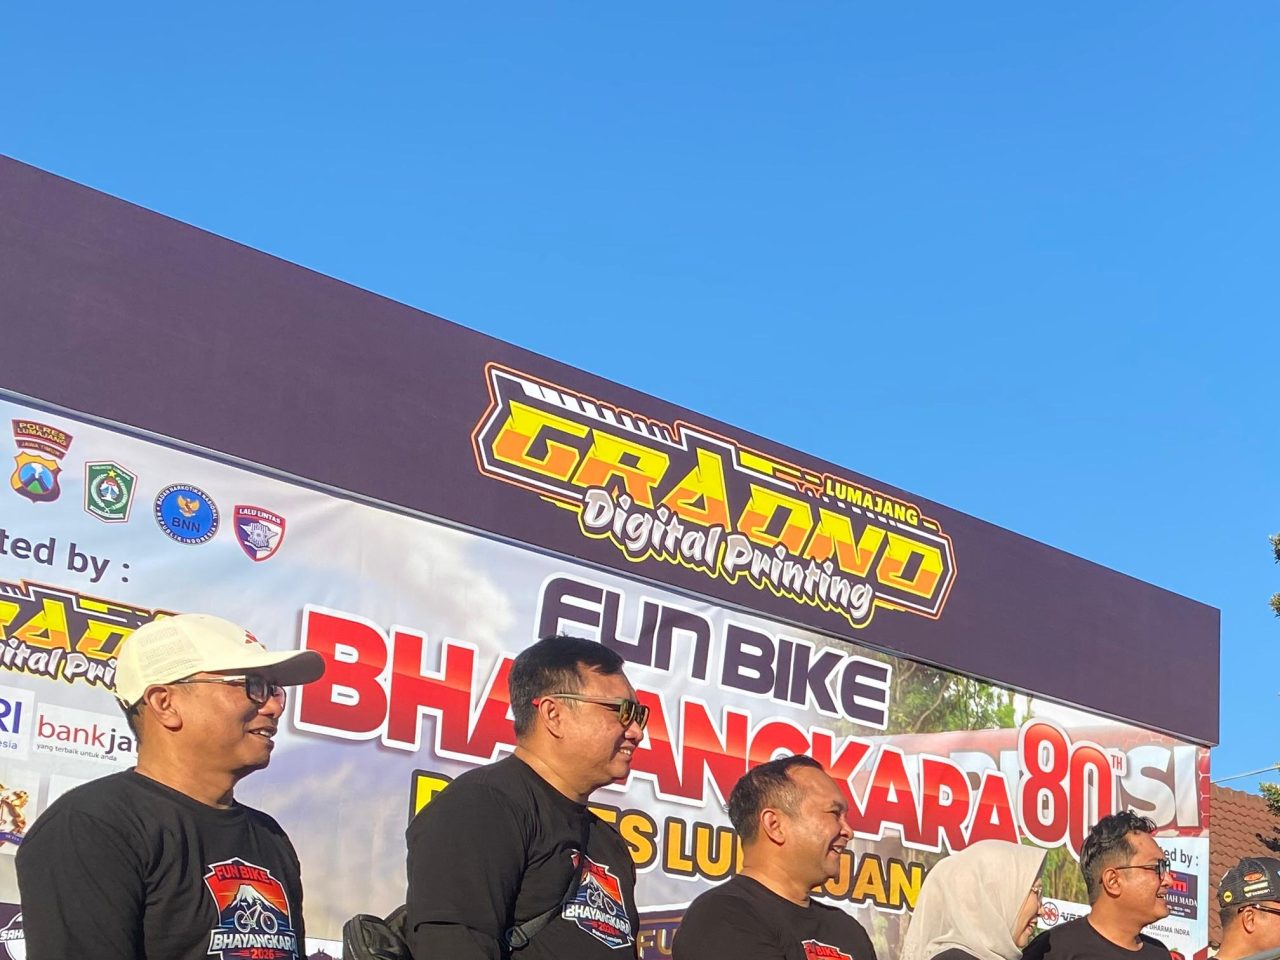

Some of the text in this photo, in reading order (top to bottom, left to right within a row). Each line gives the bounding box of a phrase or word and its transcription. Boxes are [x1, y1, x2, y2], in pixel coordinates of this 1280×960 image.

[19, 422, 66, 440] POLRES
[825, 479, 919, 526] LUMAJANG
[171, 516, 200, 533] BNN
[239, 508, 281, 524] LALU LINTAS
[67, 543, 110, 583] by
[583, 488, 873, 620] Digital Printing
[541, 579, 890, 726] FUN BIKE
[38, 714, 137, 755] bankja
[36, 743, 118, 762] yang terbaik untuk anda
[1111, 754, 1123, 771] TH
[1180, 849, 1193, 868] by
[214, 866, 269, 882] FUN BIKE
[211, 933, 297, 951] BHAYANGKARA
[251, 949, 275, 959] 2026
